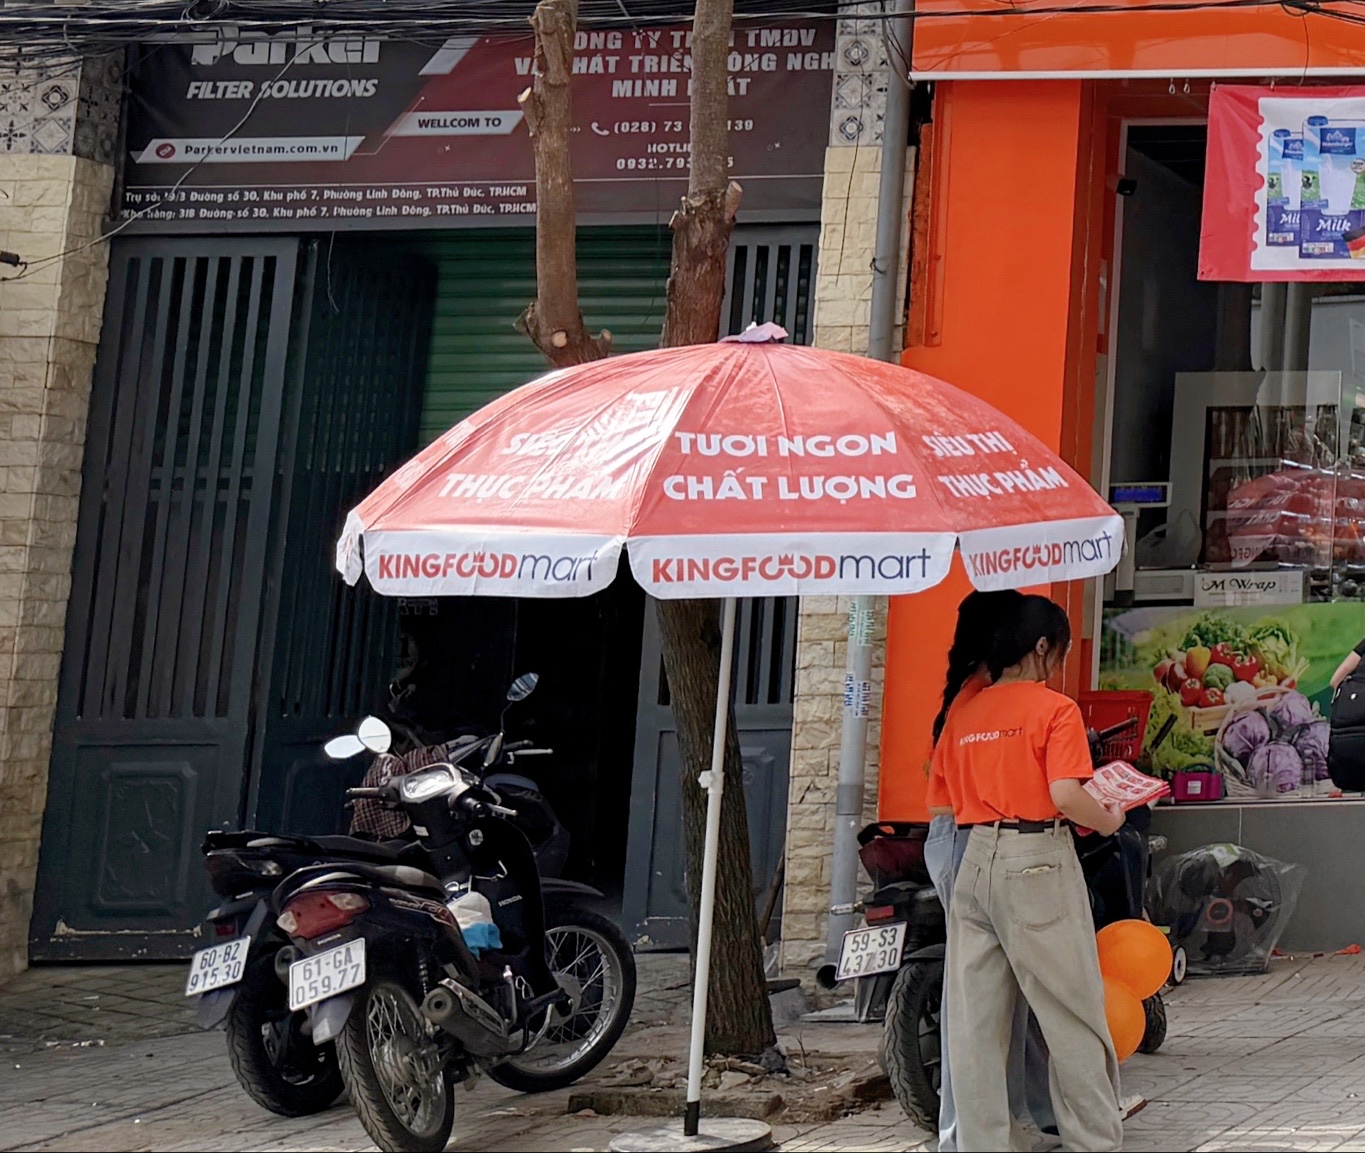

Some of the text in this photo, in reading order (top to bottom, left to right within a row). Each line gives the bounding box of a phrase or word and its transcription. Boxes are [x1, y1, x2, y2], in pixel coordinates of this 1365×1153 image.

[747, 29, 816, 48] TMDV
[186, 79, 379, 99] FILTER SOLUTIONS
[612, 79, 677, 98] MINH
[417, 117, 502, 129] WELLCOM TO
[614, 121, 682, 134] (028) 73
[263, 189, 284, 202] Khu
[273, 206, 294, 218] Khu
[1316, 219, 1351, 232] Milk
[674, 430, 1018, 458] TƯƠI NGON SIÊU THỊ
[662, 467, 768, 501] CHẤT
[777, 474, 918, 505] LƯỢNG
[937, 472, 1004, 501] THỰC
[992, 458, 1070, 494] PHẨM
[1229, 577, 1277, 595] Wrap
[850, 927, 898, 954] 59-S3
[200, 942, 241, 970] 60-B2
[302, 947, 353, 982] 61-GA
[189, 961, 242, 992] 915.30
[295, 963, 361, 1005] 059.77
